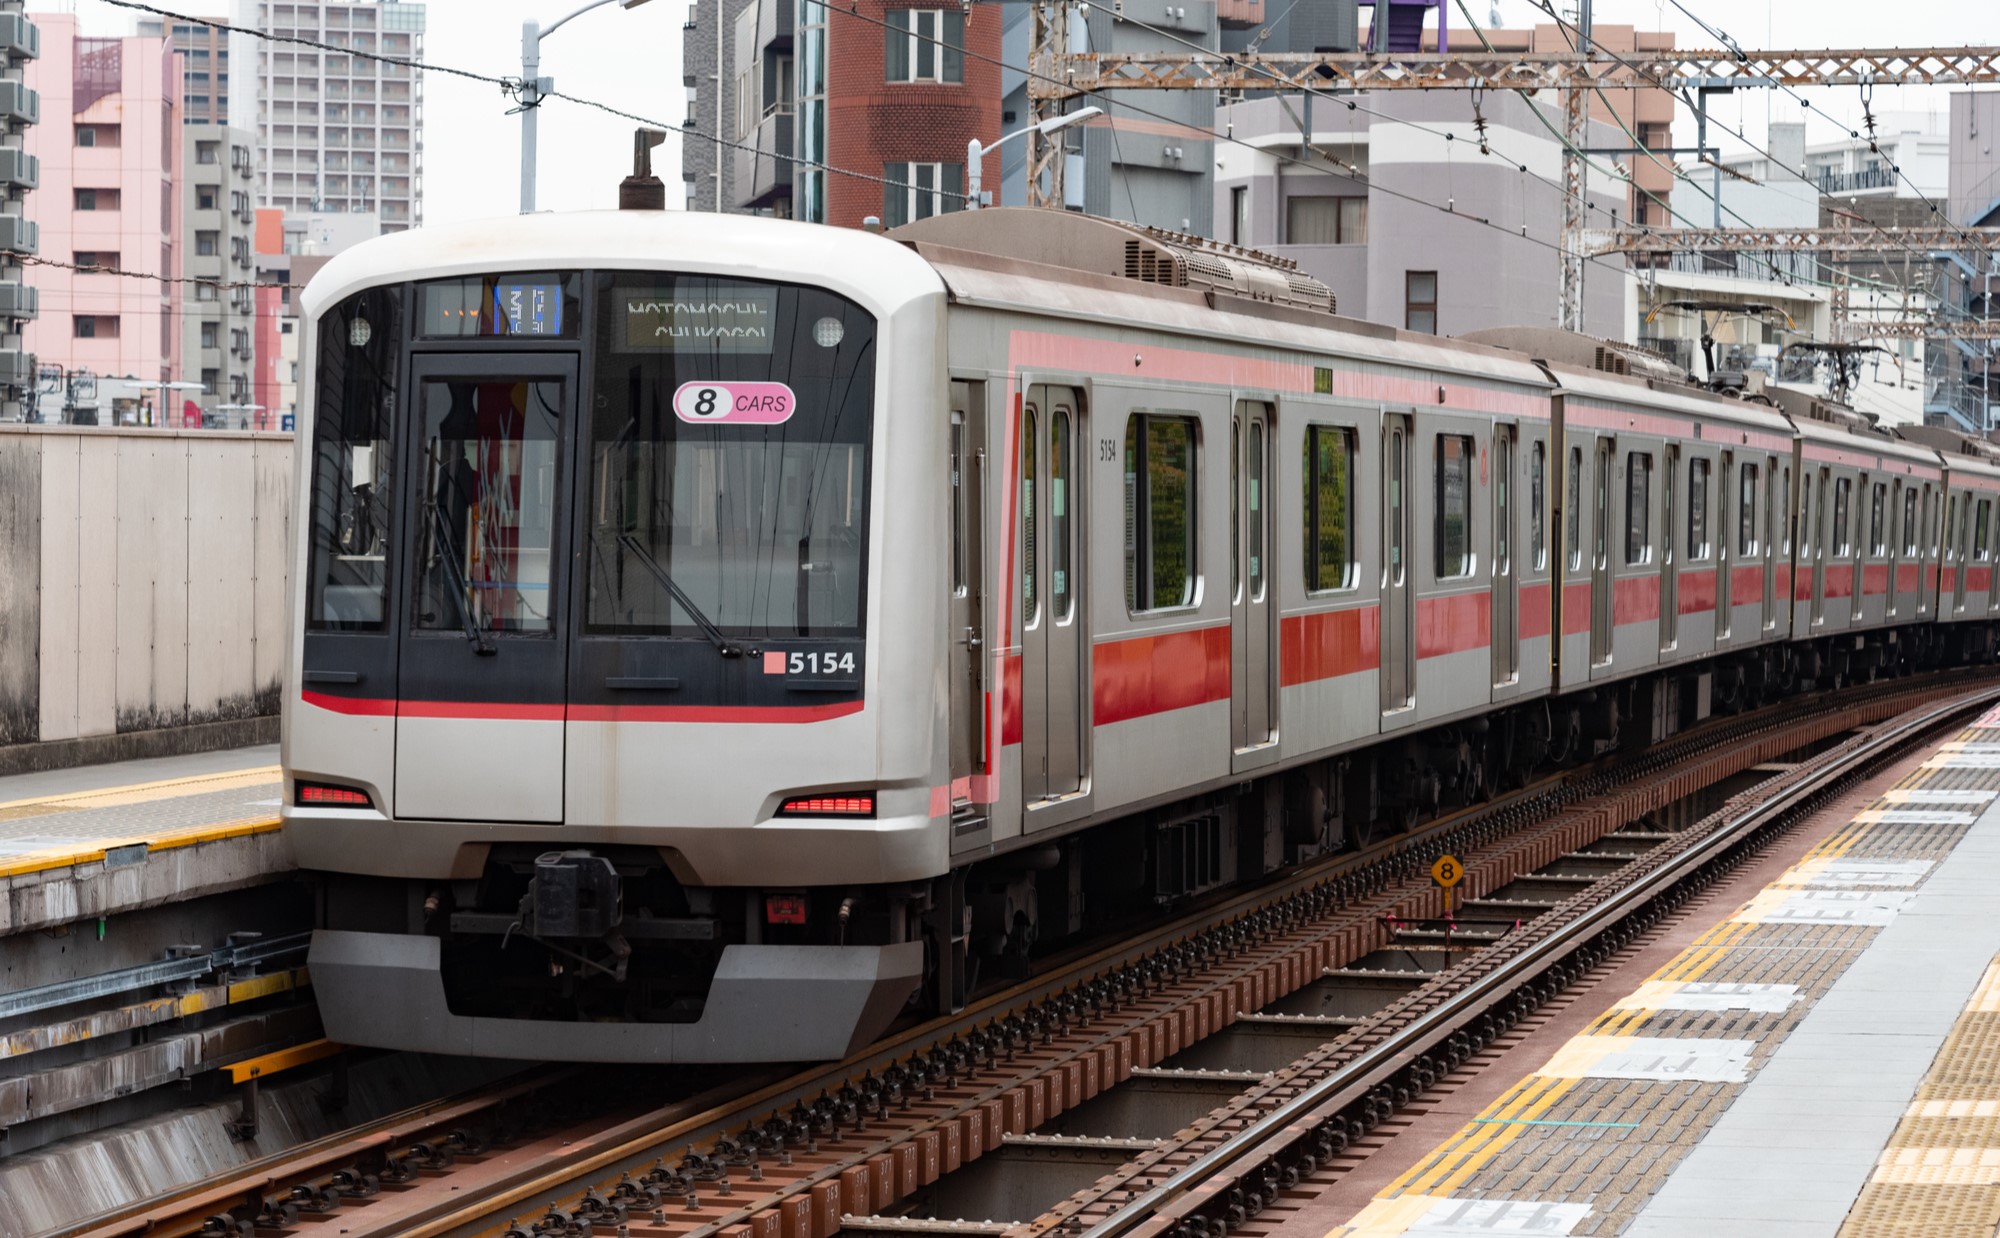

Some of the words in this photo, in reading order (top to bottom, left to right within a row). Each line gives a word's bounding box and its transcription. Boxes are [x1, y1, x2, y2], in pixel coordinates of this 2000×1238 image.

[694, 388, 717, 416] 8
[735, 395, 786, 412] CARS
[1100, 439, 1116, 462] 5154
[789, 652, 855, 674] 5154
[1441, 863, 1454, 880] 8
